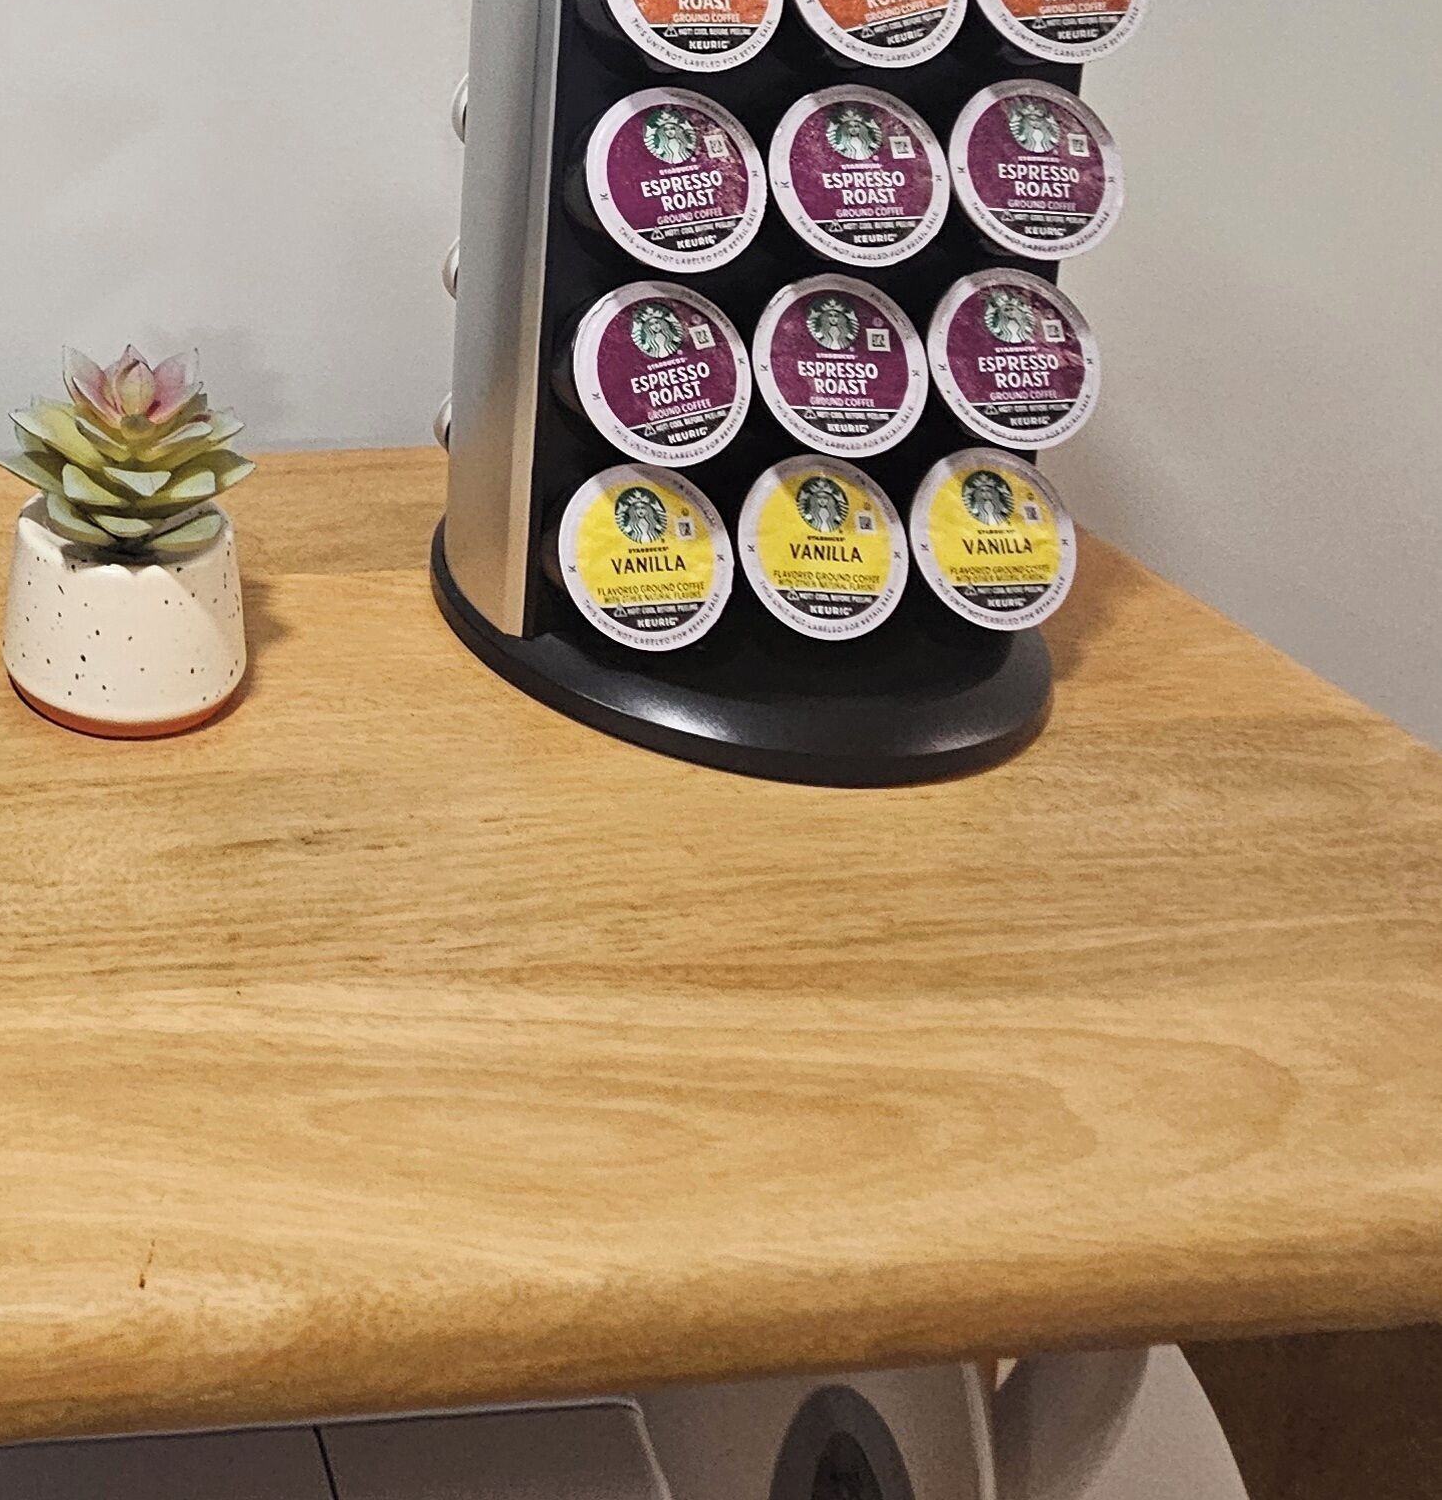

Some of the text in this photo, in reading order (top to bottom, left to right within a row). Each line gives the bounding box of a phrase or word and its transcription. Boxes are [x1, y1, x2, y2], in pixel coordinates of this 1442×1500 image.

[822, 171, 905, 189] ESPRESSO
[998, 163, 1079, 183] ESPRESSO
[640, 171, 722, 197] ESPRESSO
[1015, 181, 1071, 198] ROAST
[661, 189, 715, 212] ROAST
[843, 188, 896, 205] ROAST
[797, 361, 878, 379] ESPRESSO
[977, 355, 1058, 372] ESPRESSO
[630, 362, 710, 393] ESPRESSO
[814, 378, 868, 395] ROAST
[995, 371, 1051, 388] ROAST
[649, 381, 701, 406] ROAST
[790, 543, 863, 563] VANILLA
[962, 538, 1033, 554] VANILLA
[611, 555, 686, 575] VANILLA
